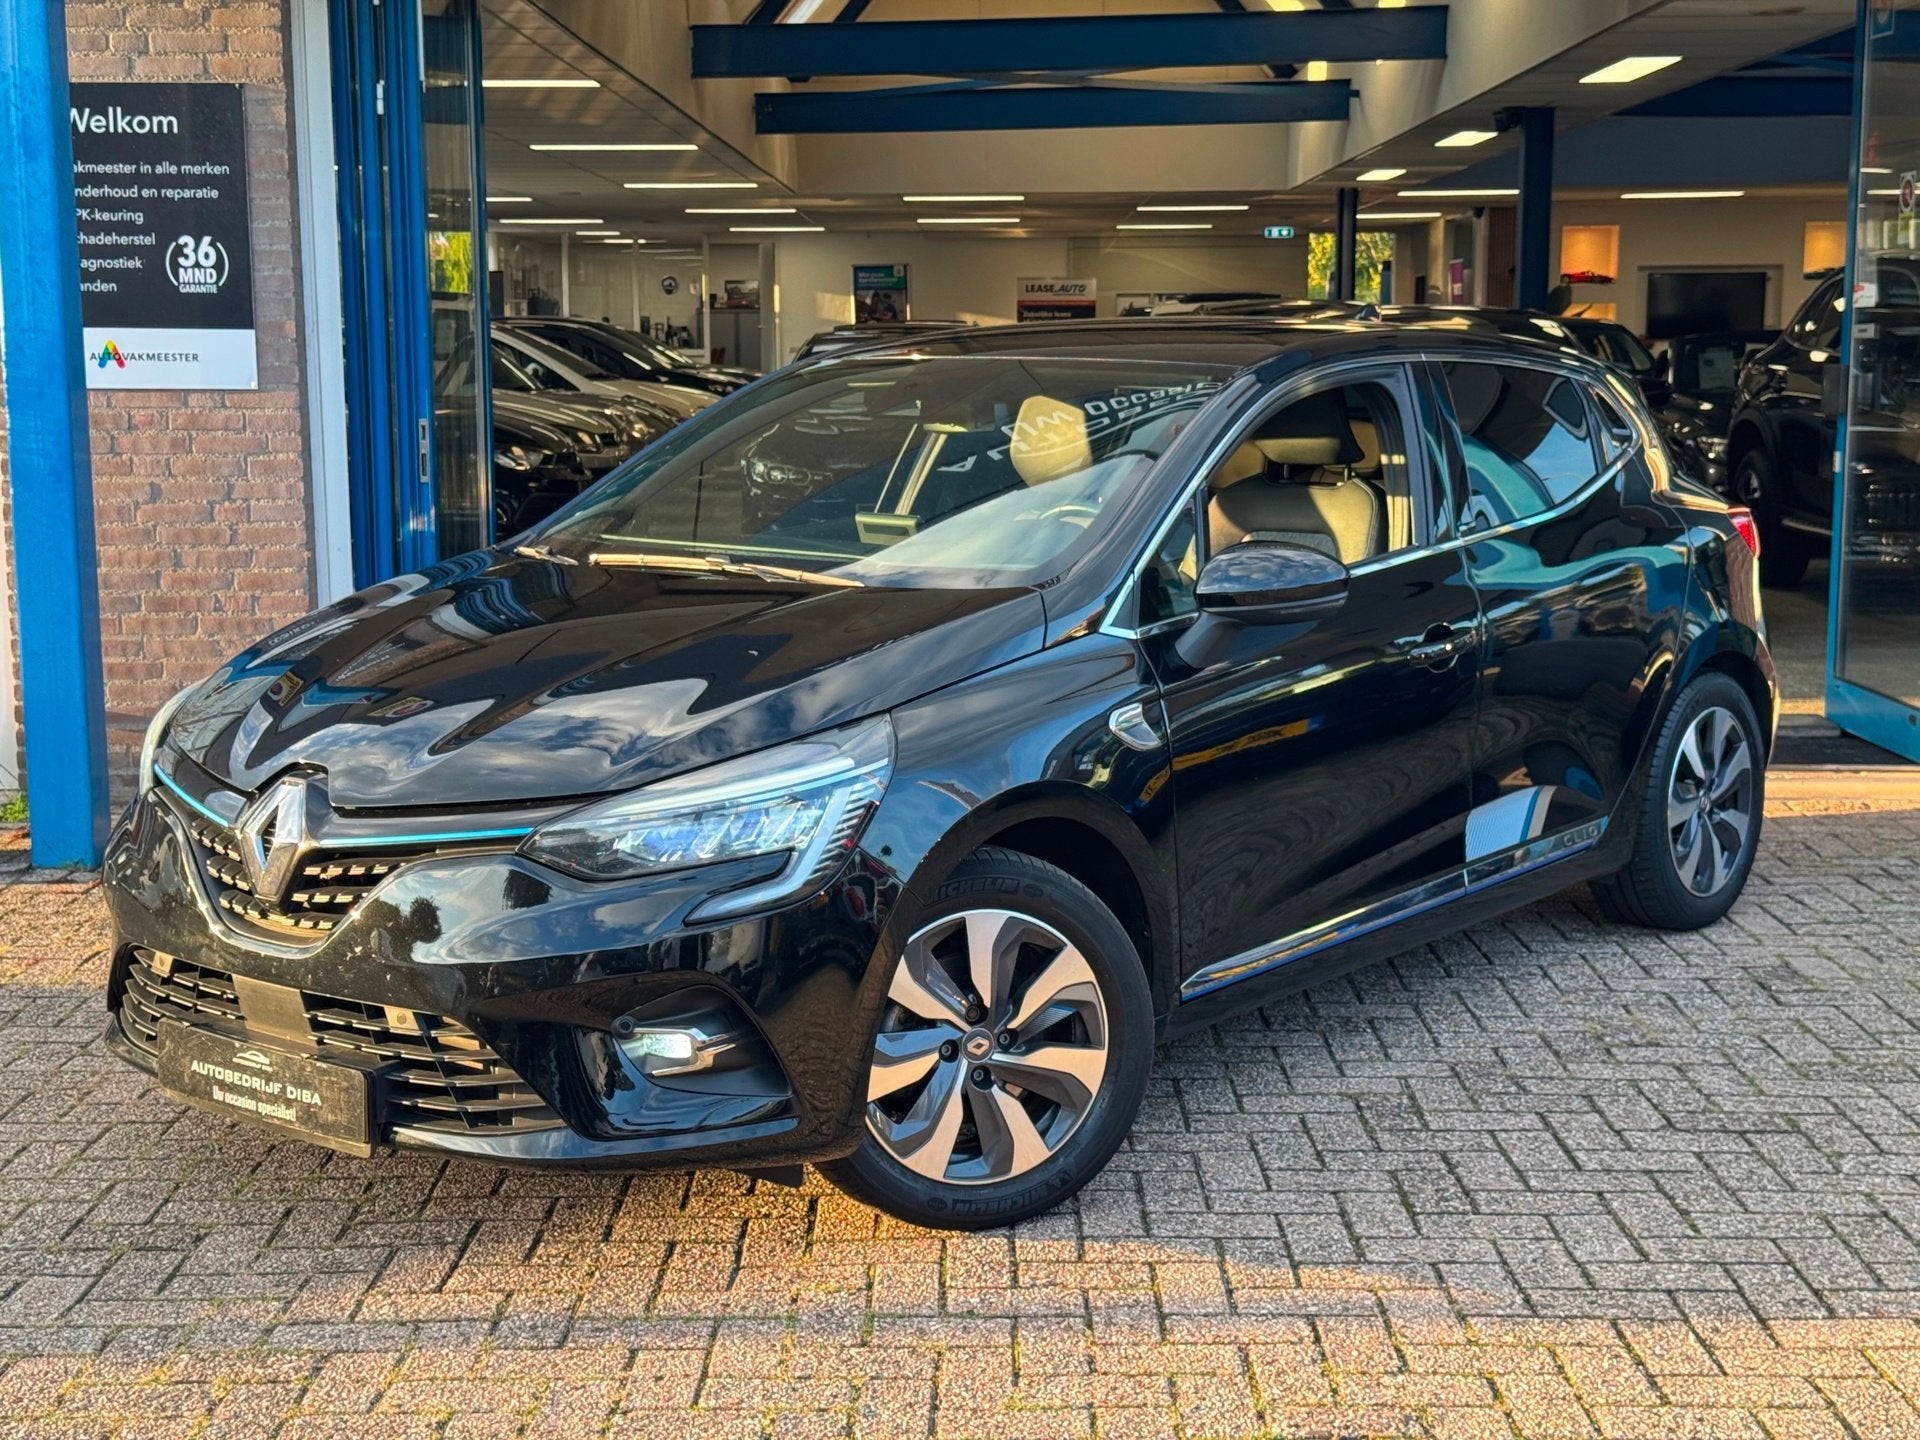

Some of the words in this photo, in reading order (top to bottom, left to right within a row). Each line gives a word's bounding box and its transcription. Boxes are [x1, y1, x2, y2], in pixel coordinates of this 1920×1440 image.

[70, 106, 178, 134] Welkom
[140, 162, 151, 174] in
[155, 161, 178, 175] alle
[181, 162, 230, 175] merken
[142, 189, 158, 198] en
[161, 187, 219, 201] reparatie
[177, 235, 217, 267] 36
[178, 267, 217, 284] MND
[178, 284, 218, 294] GARANTIE
[89, 352, 200, 362] AUTOVAKMEESTER
[1563, 826, 1598, 846] CLIO
[191, 1060, 283, 1094] AUTOBEDRIJF
[286, 1086, 322, 1106] DIBA
[212, 1085, 224, 1101] Uw
[224, 1091, 256, 1111] occasion
